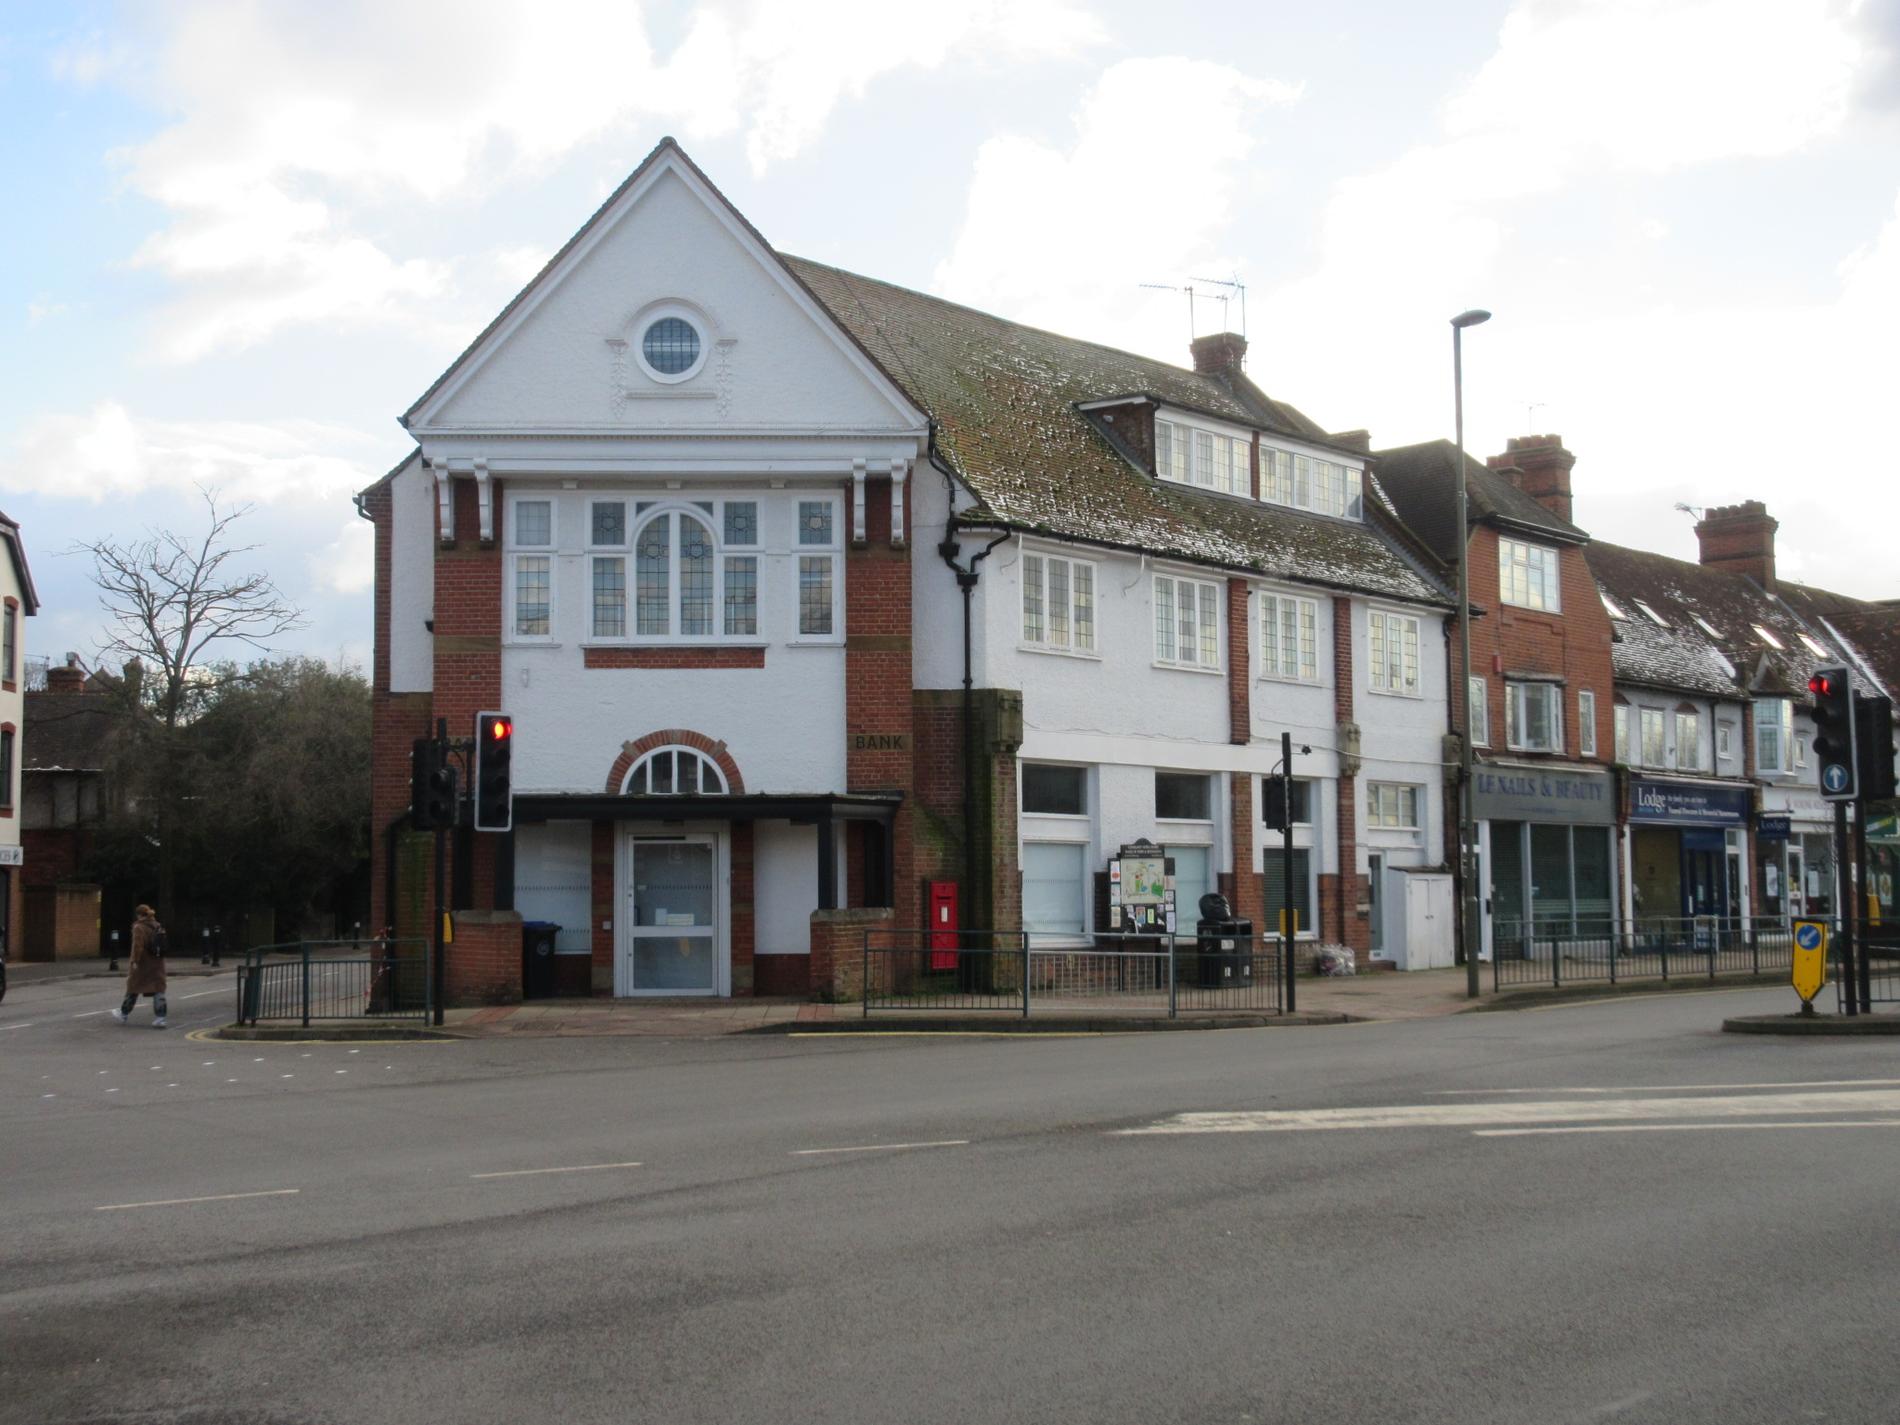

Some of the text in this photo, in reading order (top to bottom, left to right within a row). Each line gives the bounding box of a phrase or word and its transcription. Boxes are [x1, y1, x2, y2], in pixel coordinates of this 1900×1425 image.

[856, 736, 903, 750] BANK
[1477, 773, 1602, 800] LE NAILS & BEAUTY
[1638, 787, 1666, 813] Lodge
[1761, 819, 1789, 831] Lodge
